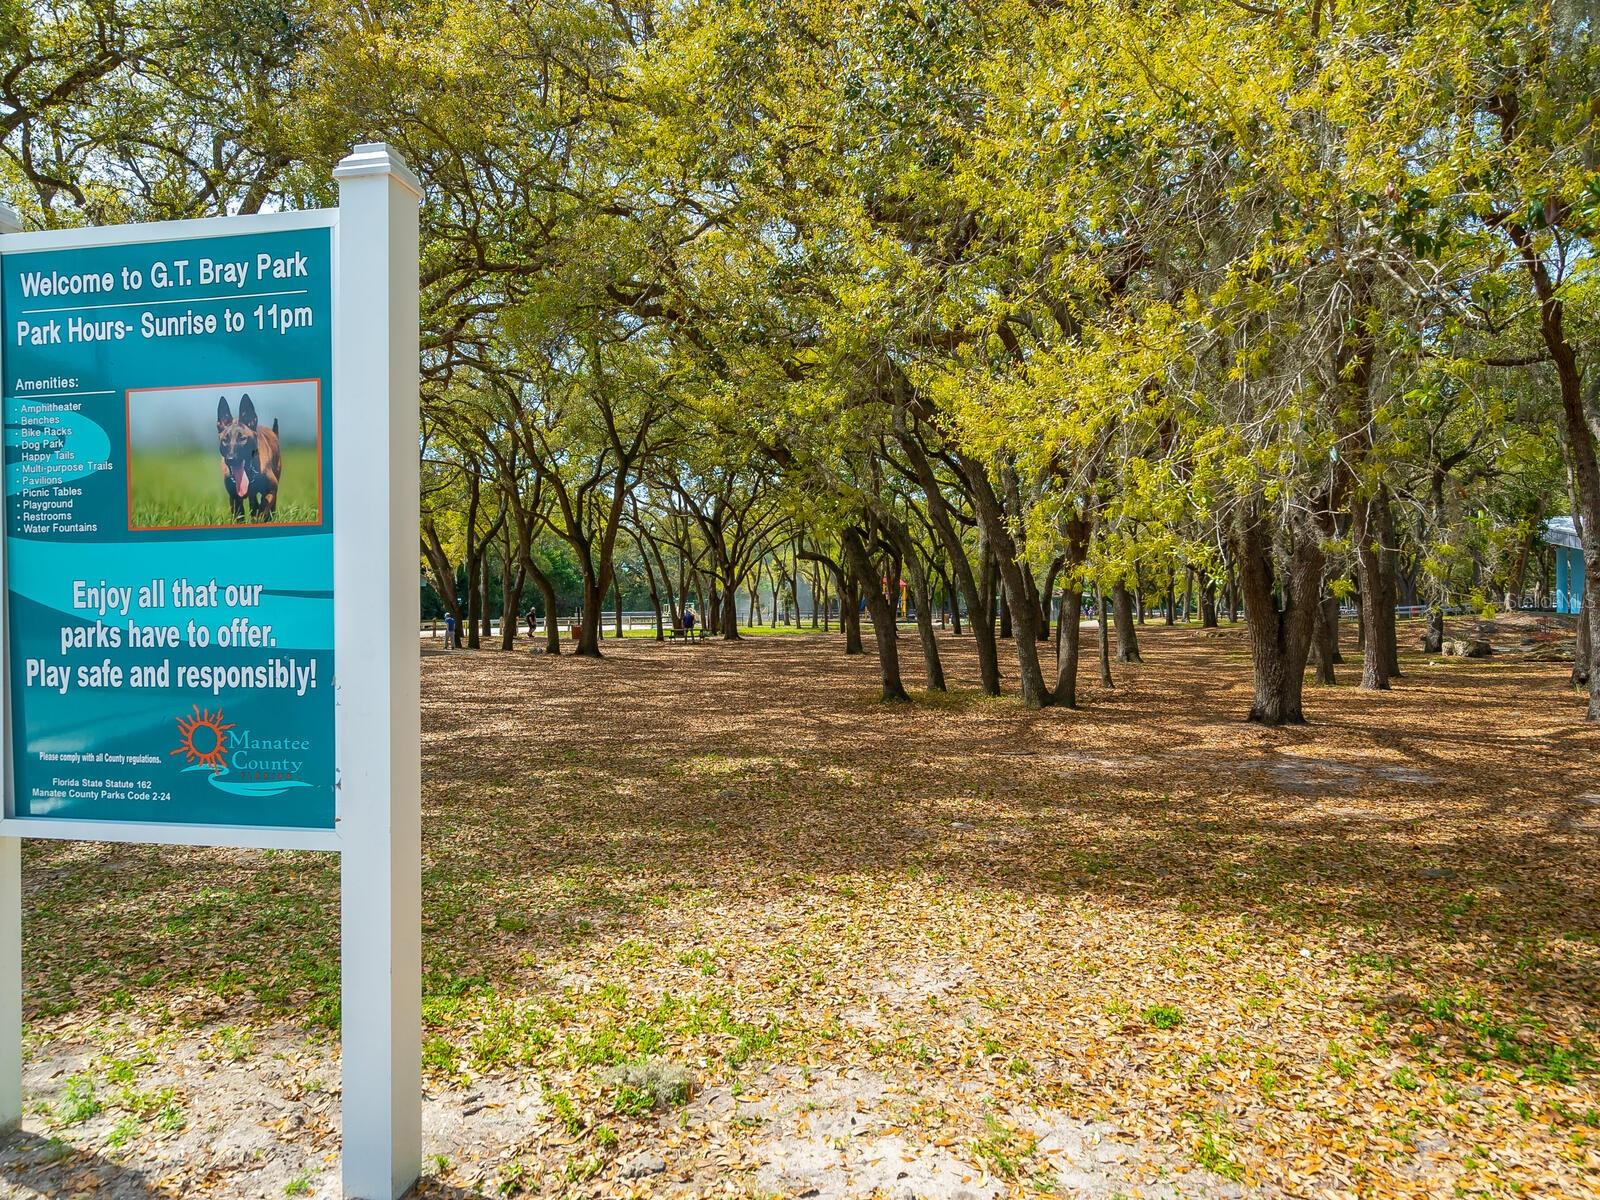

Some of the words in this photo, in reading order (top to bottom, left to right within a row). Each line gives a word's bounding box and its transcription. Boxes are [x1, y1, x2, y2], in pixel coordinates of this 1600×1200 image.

[20, 270, 114, 298] Welcome
[121, 266, 143, 290] to
[150, 260, 192, 288] G.T.
[199, 258, 249, 288] Bray
[256, 251, 308, 280] Park
[16, 320, 61, 346] Park
[68, 316, 134, 343] Hours-
[140, 310, 217, 339] Sunrise
[224, 308, 245, 333] to
[253, 303, 313, 335] 11pm
[15, 377, 79, 391] Amenities:
[21, 402, 82, 414] Amphitheater
[21, 416, 60, 426] Benches
[21, 428, 41, 437] Bike
[44, 427, 73, 436] Racks
[21, 440, 40, 451] Dog
[43, 439, 64, 448] Park
[21, 452, 51, 462] Happy
[54, 450, 75, 460] Tails
[22, 463, 84, 475] Multi-purpose
[88, 461, 113, 471] Trails
[22, 476, 63, 485] Pavilions
[22, 488, 50, 497] Picnic
[53, 487, 82, 496] Tables
[23, 499, 73, 511] Playground
[23, 512, 72, 521] Restrooms
[23, 524, 50, 533] Water
[52, 523, 97, 533] Fountains
[72, 580, 133, 616] Enjoy
[138, 579, 165, 608] all
[172, 578, 217, 608] that
[224, 583, 263, 607] our
[60, 619, 121, 655] parks
[128, 619, 180, 648] have
[187, 618, 210, 648] to
[217, 617, 277, 648] offer.
[25, 658, 71, 695] Play
[77, 658, 123, 688] safe
[130, 658, 170, 688] and
[177, 658, 317, 696] responsibly!
[227, 730, 310, 750] Manatee
[39, 751, 59, 761] Please
[60, 752, 80, 763] comply
[82, 753, 95, 762] with
[104, 753, 125, 765] County
[126, 754, 162, 765] regulations.
[231, 750, 303, 773] County
[52, 777, 80, 787] Florida
[82, 778, 103, 788] State
[105, 779, 134, 788] Statute
[137, 780, 152, 789] 162
[32, 788, 67, 797] Manatee
[68, 790, 99, 800] County
[101, 790, 125, 800] Parks
[127, 791, 150, 800] Code
[152, 792, 171, 801] 2-24
